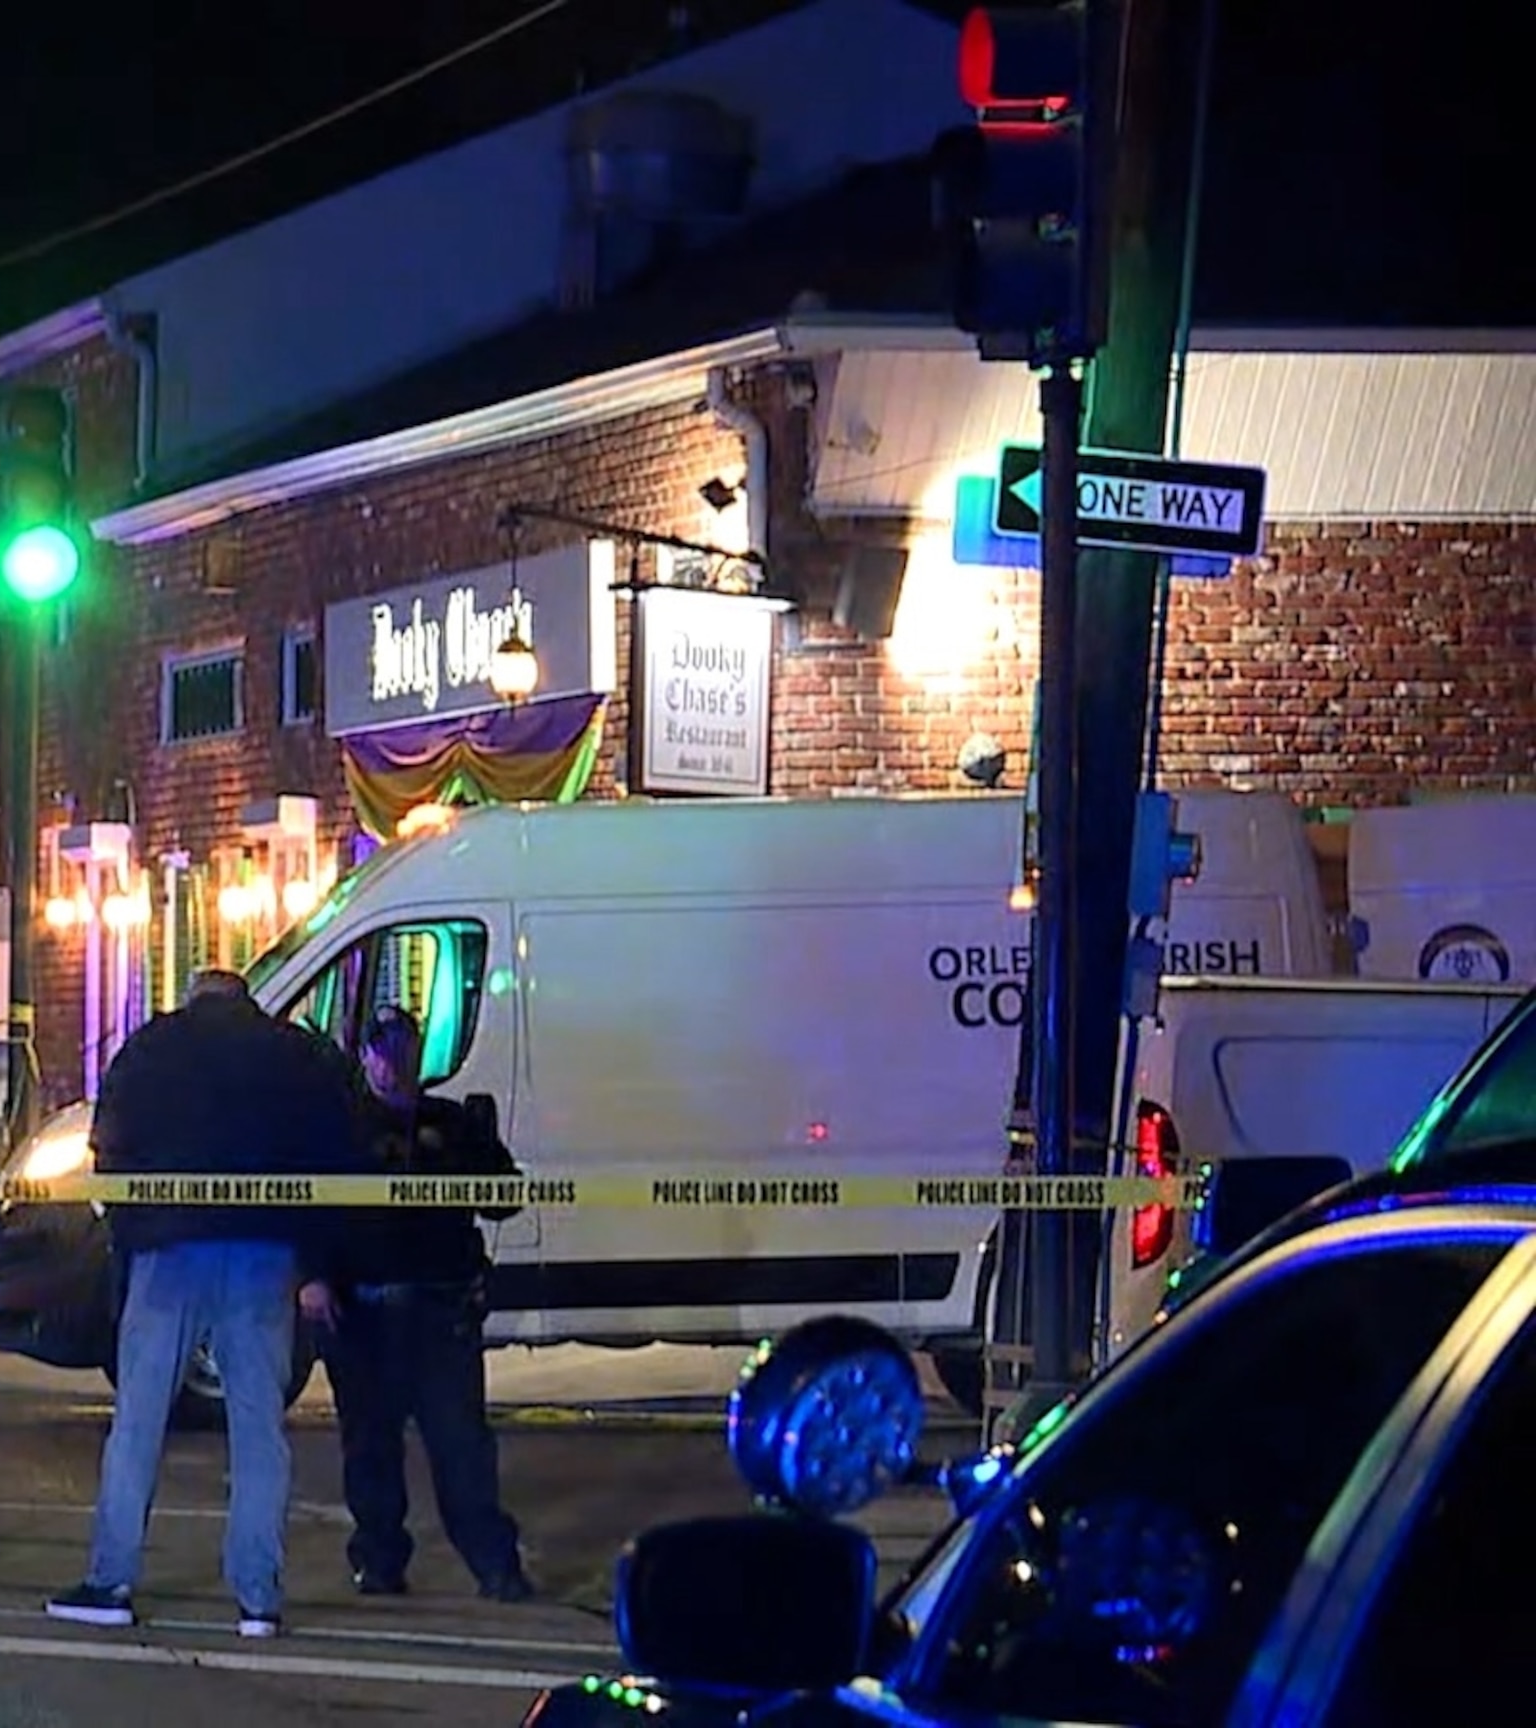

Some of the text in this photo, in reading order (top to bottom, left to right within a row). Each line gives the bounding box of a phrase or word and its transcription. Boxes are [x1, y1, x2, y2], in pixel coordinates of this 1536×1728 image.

[1078, 479, 1233, 525] ONE WAY
[672, 630, 745, 683] Dooky
[666, 677, 746, 716] Chase's
[665, 717, 747, 749] Restaurant
[930, 940, 1260, 980] ORLE RISH
[952, 982, 1025, 1027] CO
[128, 1180, 313, 1200] POLICE LINE DO NOT CROSS
[390, 1180, 575, 1202] POLICE LINE DO NOT CROSS
[652, 1181, 839, 1204] POLICE LINE DO NOT CROSS
[916, 1182, 1104, 1204] POLICE LINE DO NOT CROSS
